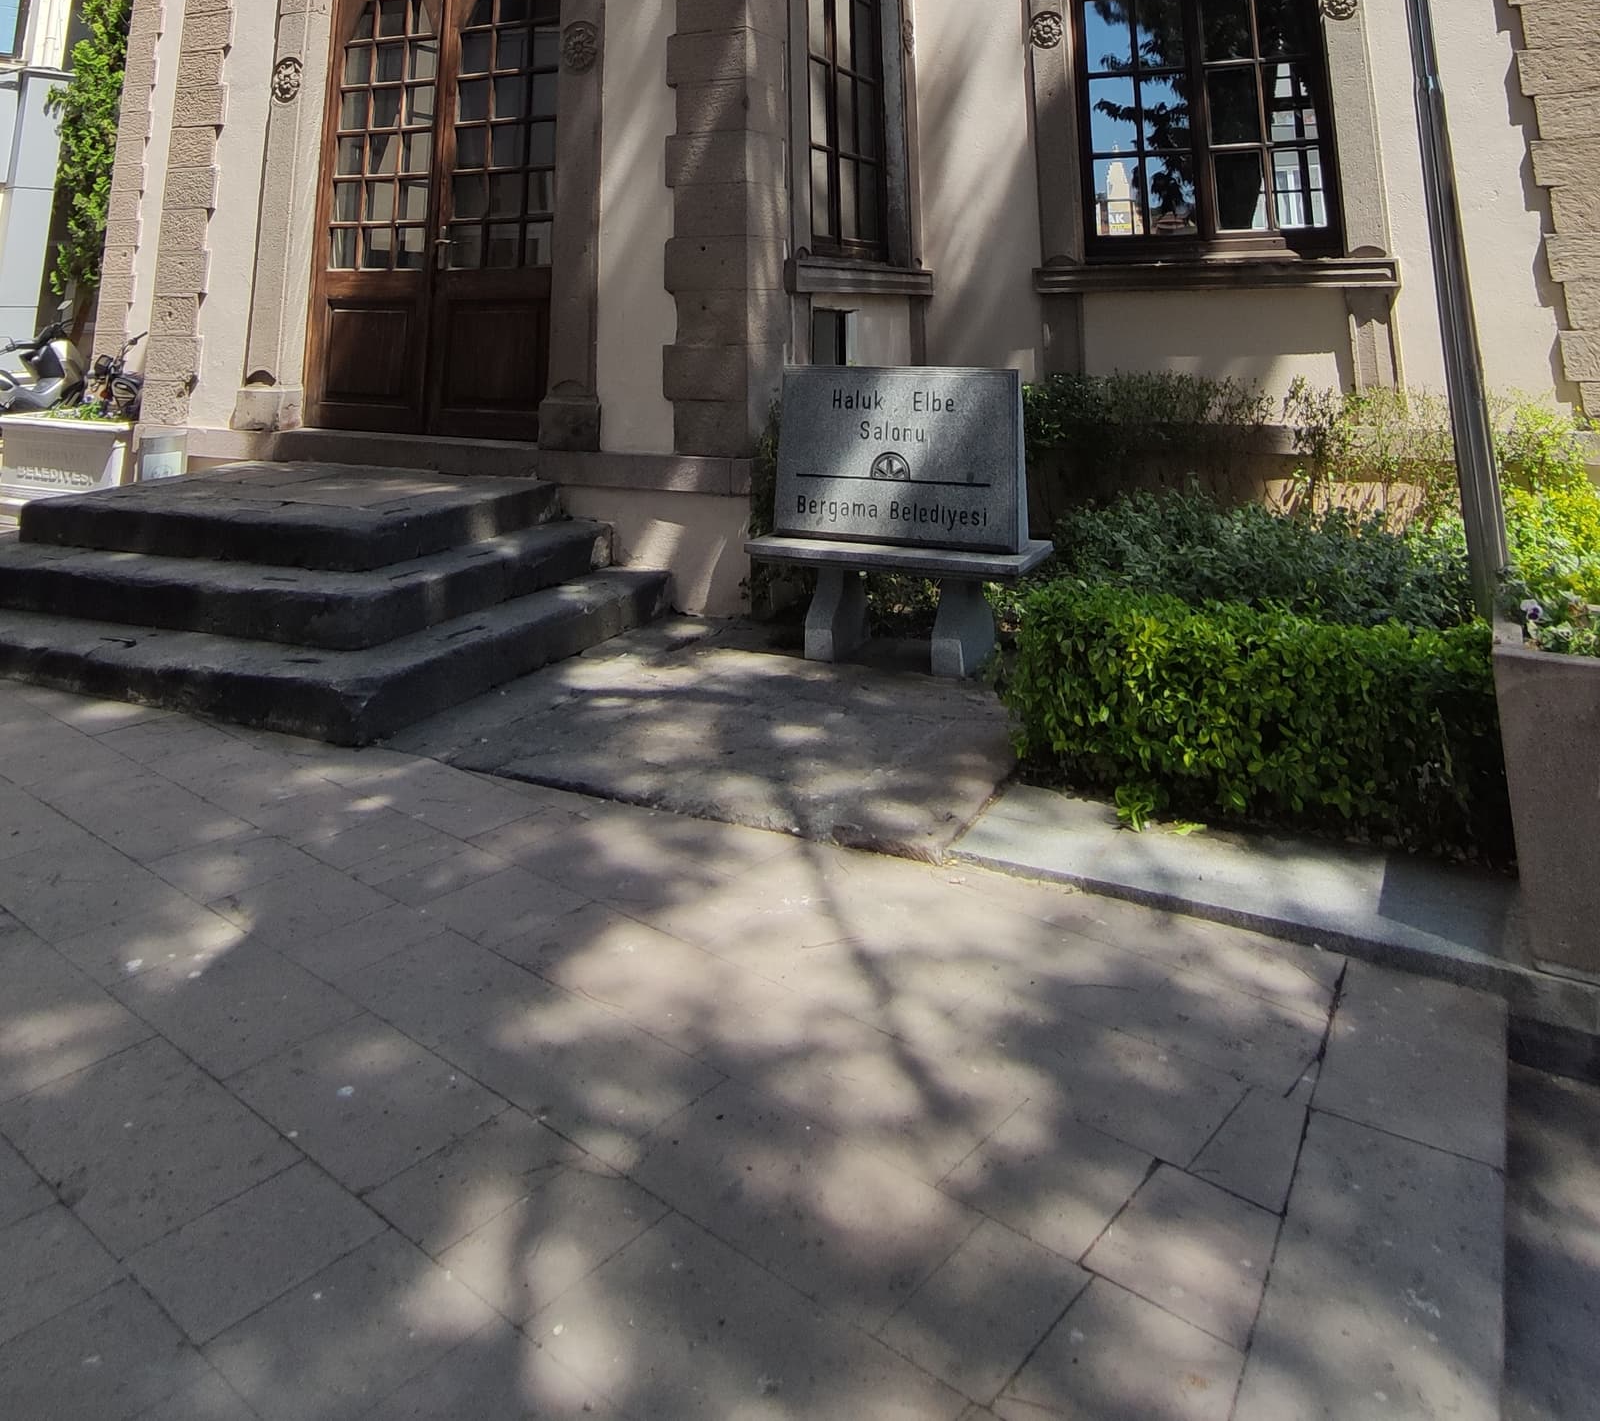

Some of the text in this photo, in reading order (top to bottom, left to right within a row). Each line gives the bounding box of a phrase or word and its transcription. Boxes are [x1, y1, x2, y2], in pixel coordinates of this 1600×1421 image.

[832, 389, 954, 412] Haluk Elbe
[859, 420, 925, 443] Salonu
[796, 495, 987, 531] Bergama Belediyesi
